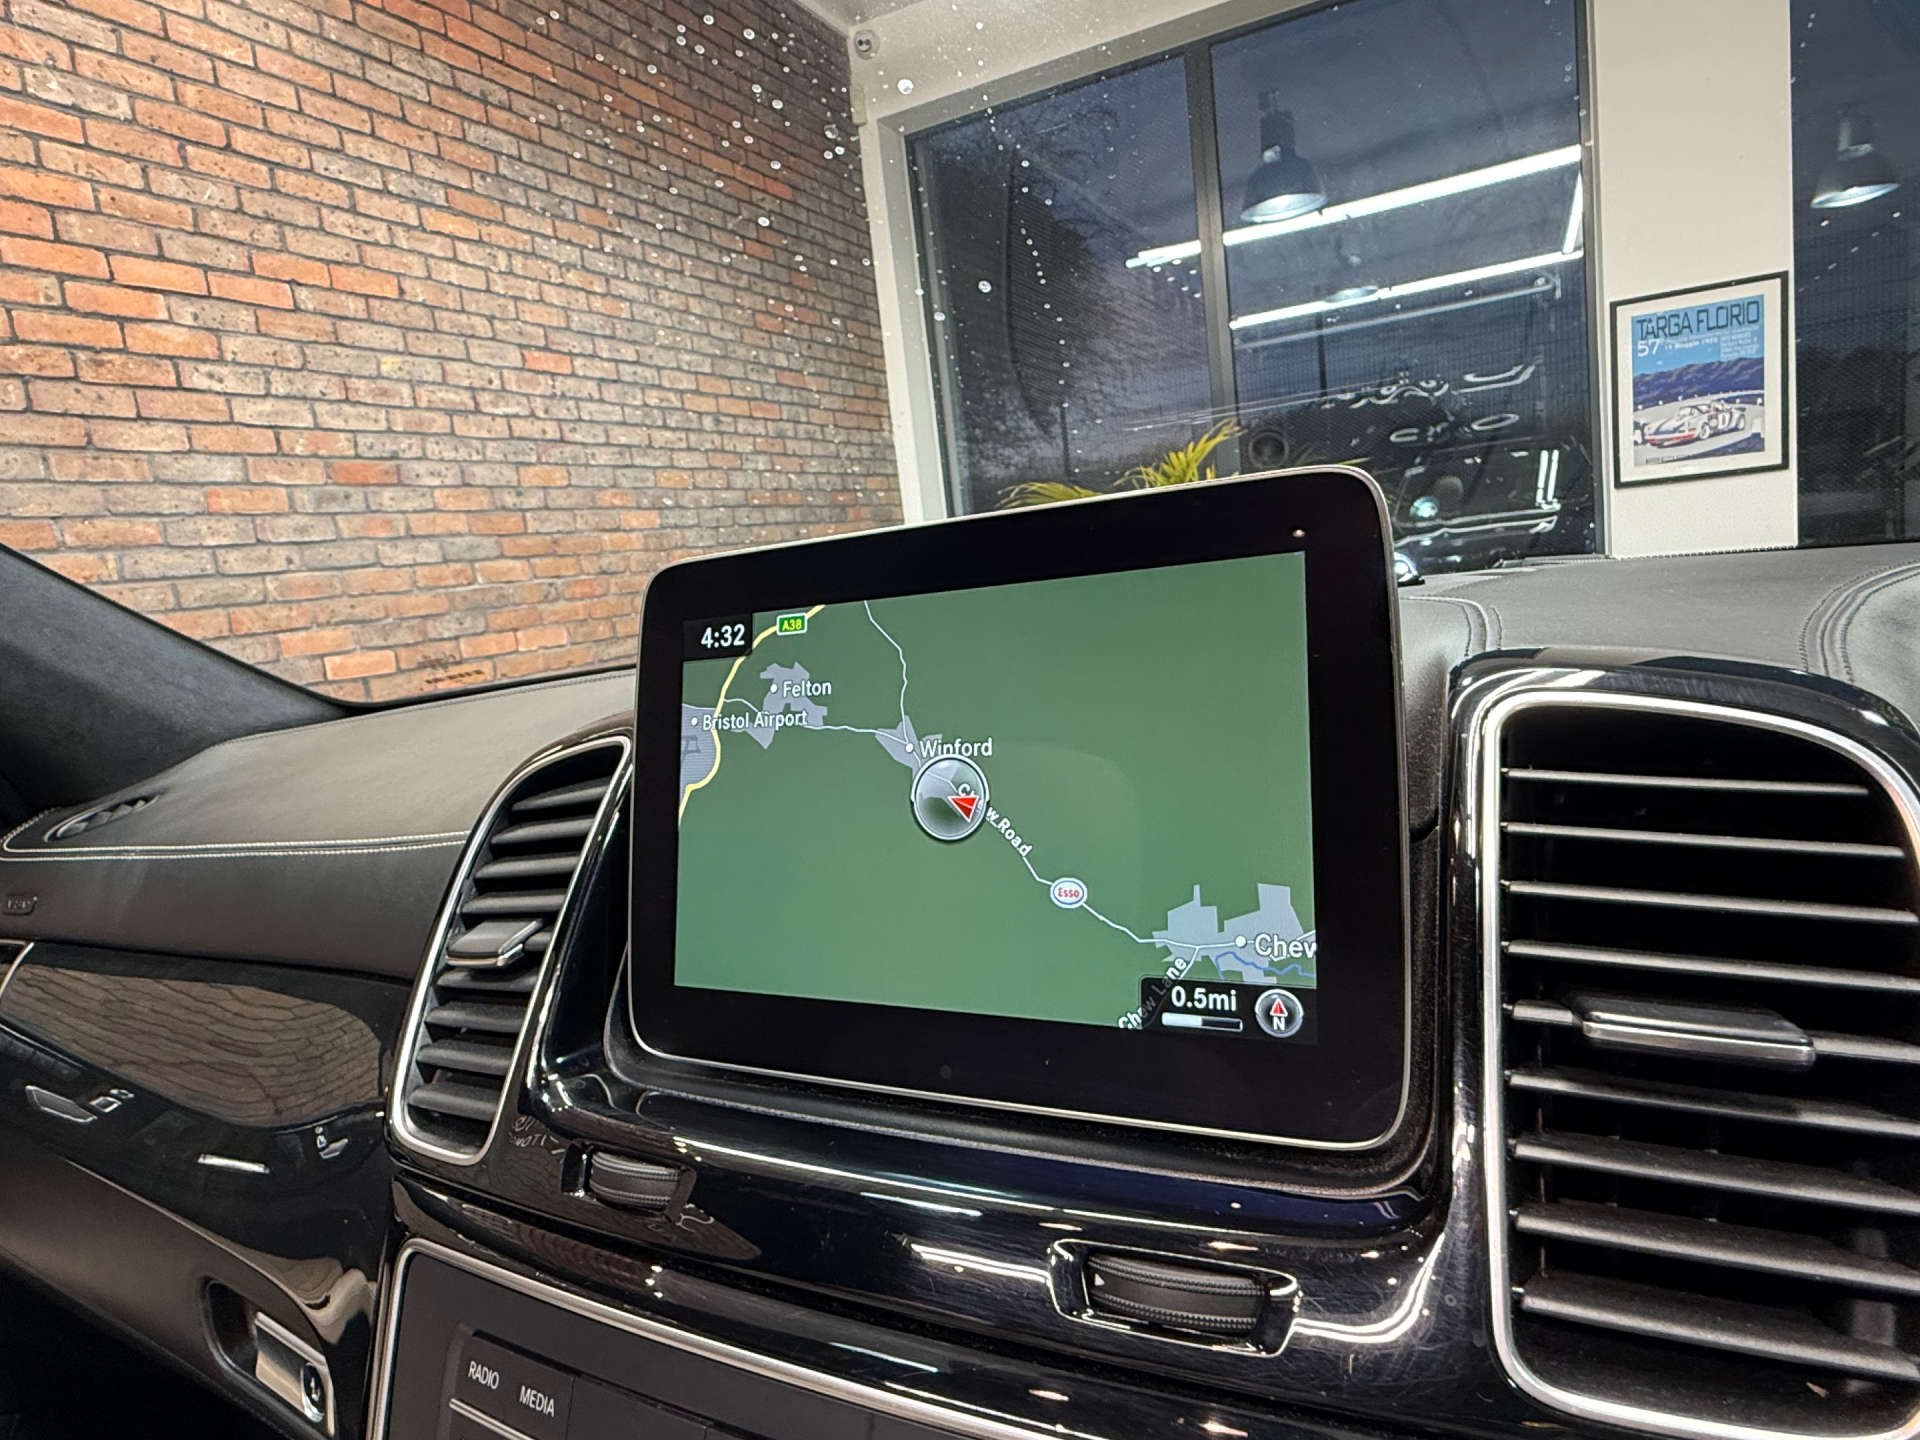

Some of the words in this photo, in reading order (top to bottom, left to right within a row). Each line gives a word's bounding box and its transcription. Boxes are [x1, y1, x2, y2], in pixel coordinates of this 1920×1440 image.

[1636, 312, 1693, 340] TARGA
[1696, 300, 1760, 332] FLORIO
[700, 623, 745, 648] 4:32
[781, 619, 803, 632] A38
[783, 680, 832, 697] Felton
[703, 712, 749, 730] Bristol
[753, 710, 808, 731] Airport
[919, 737, 993, 758] Winford
[998, 818, 1033, 857] Road
[1057, 887, 1080, 898] Esso
[1151, 958, 1187, 996] Lane
[1171, 985, 1237, 1012] 0.5mi
[1273, 1016, 1286, 1031] N
[467, 1360, 500, 1390] RADIO
[520, 1385, 555, 1417] MEDIA
